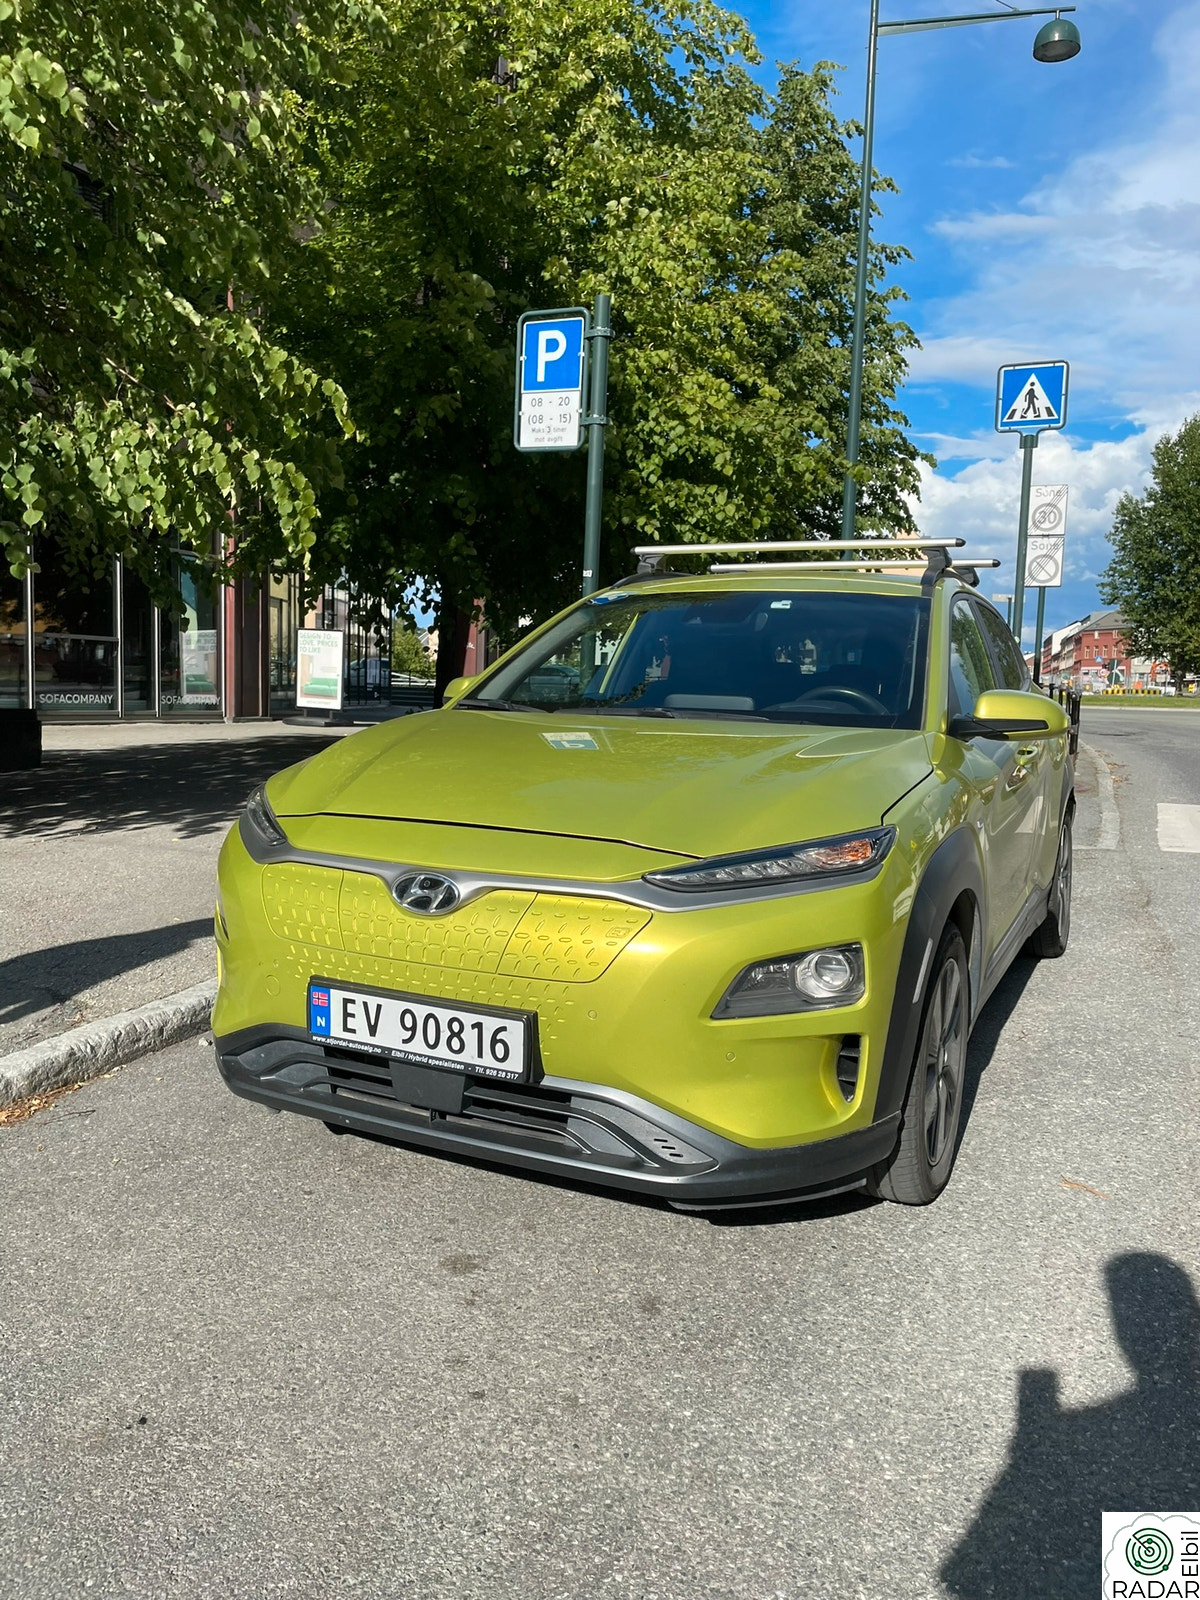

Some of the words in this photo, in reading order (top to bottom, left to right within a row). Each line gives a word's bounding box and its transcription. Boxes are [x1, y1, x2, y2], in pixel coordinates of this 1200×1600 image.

[537, 329, 567, 383] P
[531, 397, 543, 408] 08
[558, 396, 570, 407] 20
[528, 414, 544, 425] (08
[559, 412, 572, 424] 15)
[1038, 510, 1057, 524] 30
[299, 632, 321, 640] DESIGN
[39, 694, 113, 704] SOFACOMPANY
[161, 695, 221, 705] SOFACOMPANY
[317, 1015, 326, 1027] N
[342, 997, 383, 1038] EV
[399, 1008, 510, 1063] 90816
[391, 1050, 405, 1059] Elbil
[408, 1053, 428, 1064] Hybrid
[428, 1057, 464, 1070] spesialisten
[485, 1067, 497, 1077] 926
[506, 1071, 519, 1080] 317
